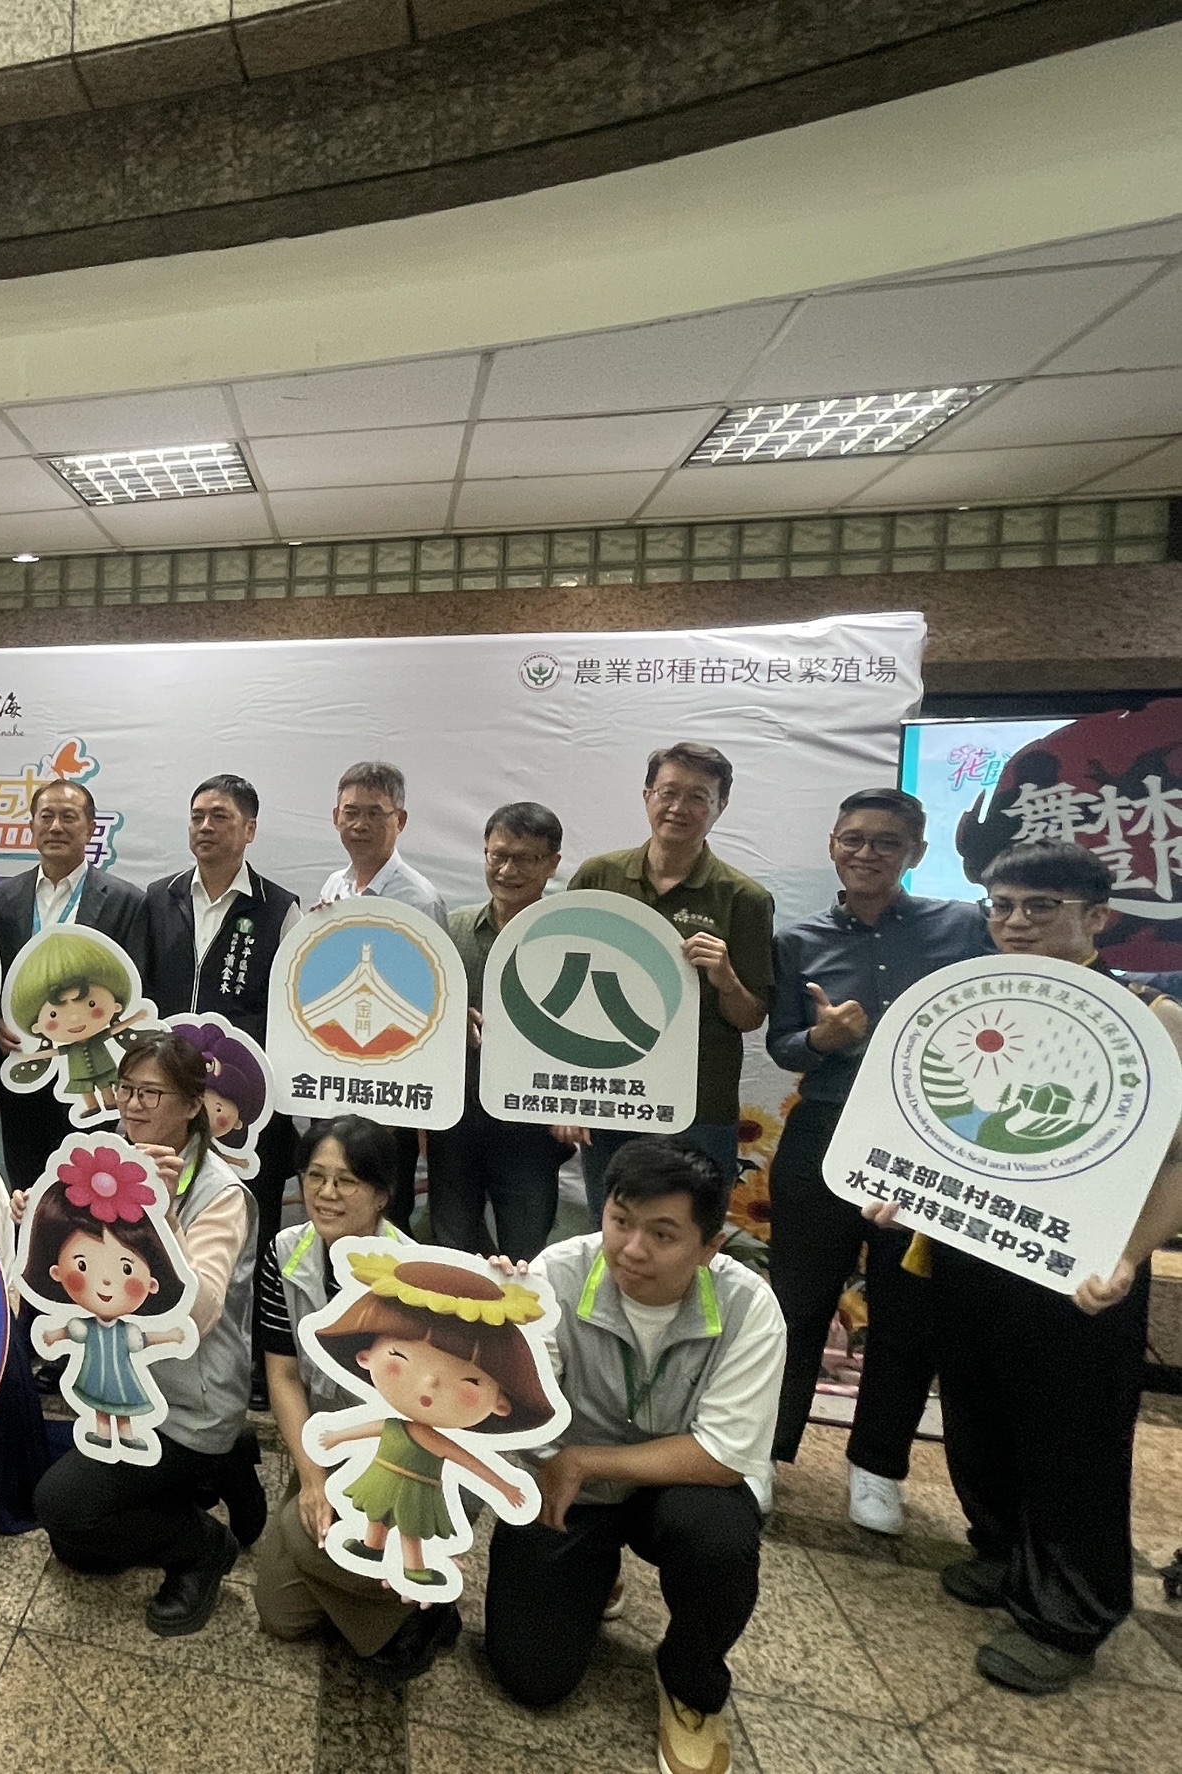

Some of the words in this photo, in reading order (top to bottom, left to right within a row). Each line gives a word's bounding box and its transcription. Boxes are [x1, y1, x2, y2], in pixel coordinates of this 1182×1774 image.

[573, 655, 898, 685] 農業部種苗改良繁殖場
[354, 999, 372, 1036] 金門
[291, 1072, 433, 1110] 金門縣政府
[532, 1072, 646, 1097] 農業部林業及
[504, 1093, 675, 1122] 自然保育署臺中分署
[966, 1151, 988, 1167] Soil
[988, 1157, 1012, 1171] and
[1013, 1160, 1049, 1172] Water
[866, 1147, 1071, 1243] 農業部農村發展及
[845, 1170, 1077, 1277] 水土保持署臺中分署
